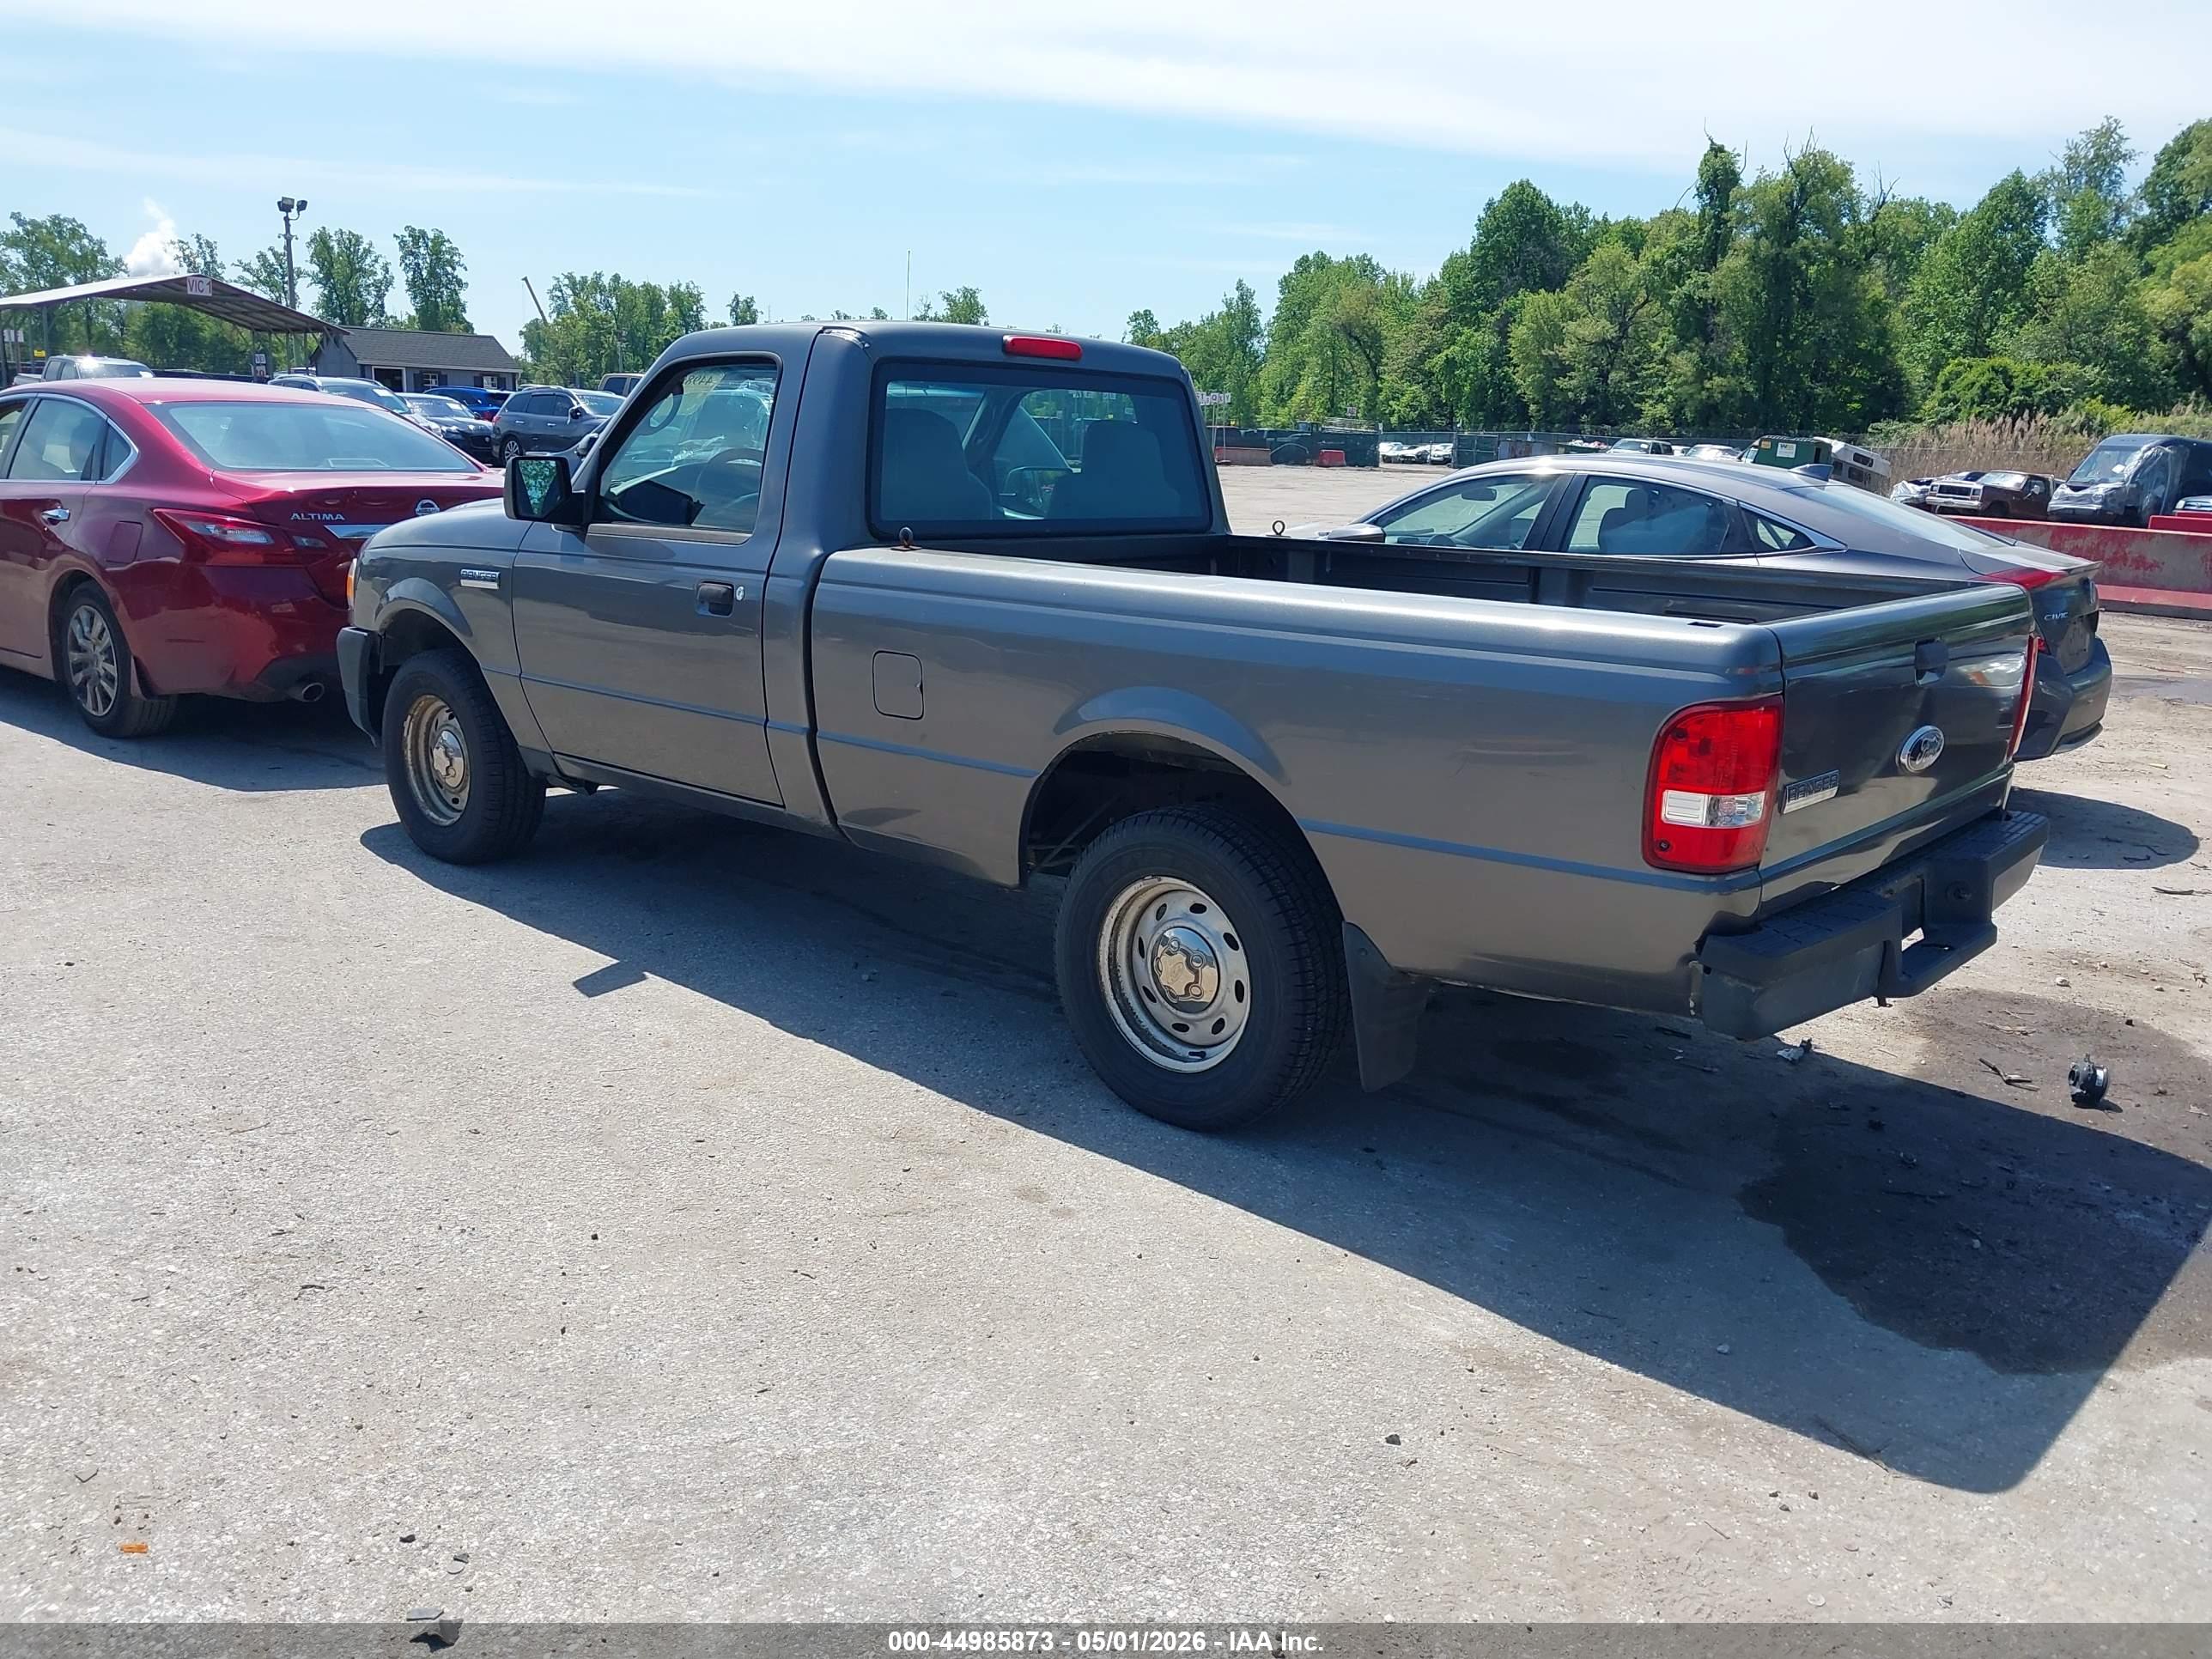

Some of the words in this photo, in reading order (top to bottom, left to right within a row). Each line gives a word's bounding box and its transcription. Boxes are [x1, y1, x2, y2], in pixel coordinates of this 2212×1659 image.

[188, 279, 204, 292] VIC
[206, 282, 211, 293] 1
[461, 570, 497, 581] RANGER
[2044, 611, 2069, 621] CIVIC
[1787, 772, 1838, 804] RANGER
